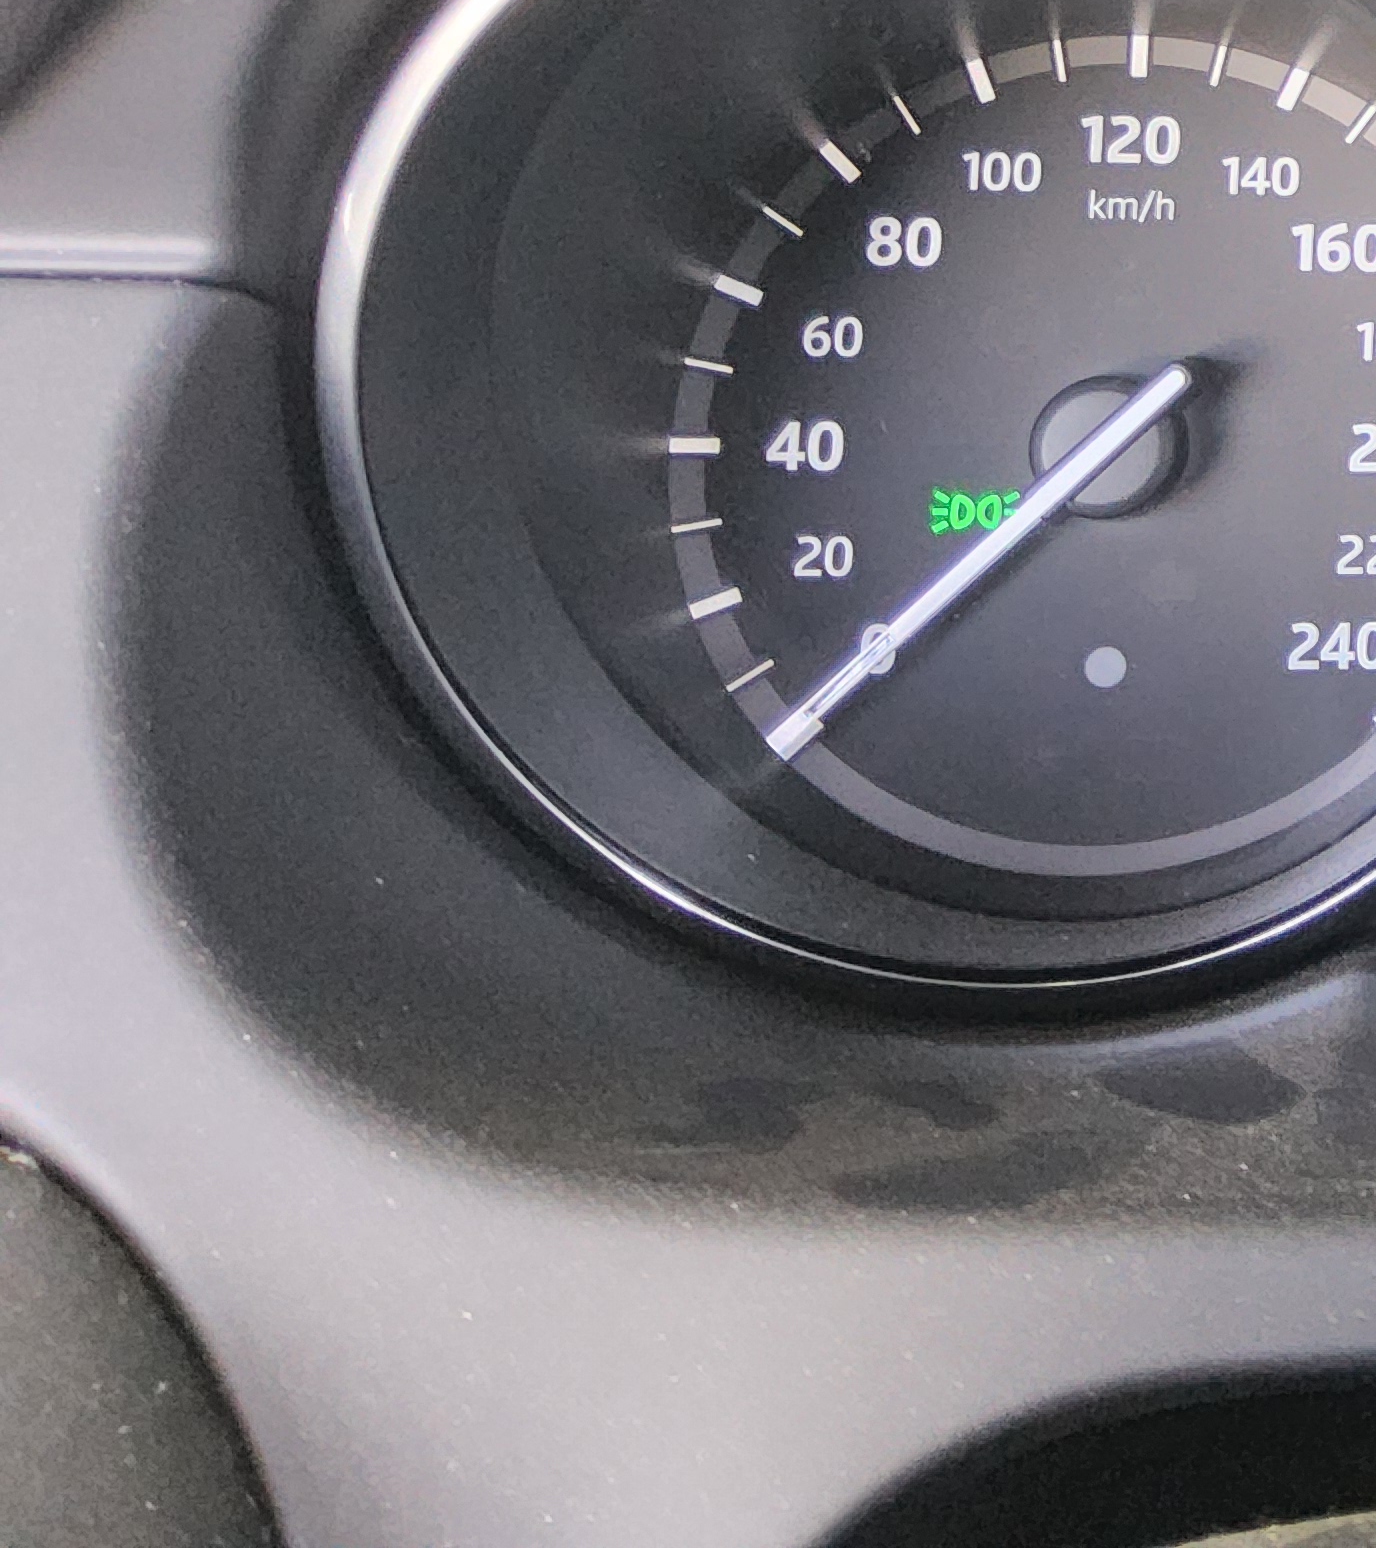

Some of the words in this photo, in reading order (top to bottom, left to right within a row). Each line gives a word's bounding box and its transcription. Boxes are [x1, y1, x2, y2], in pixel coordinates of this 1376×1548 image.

[1081, 115, 1181, 165] 120
[962, 151, 1042, 192] 100
[1222, 156, 1300, 197] 140
[1088, 189, 1175, 223] km/h
[866, 216, 943, 267] 80
[802, 315, 864, 358] 60
[765, 420, 844, 472] 40
[793, 535, 854, 577] 20
